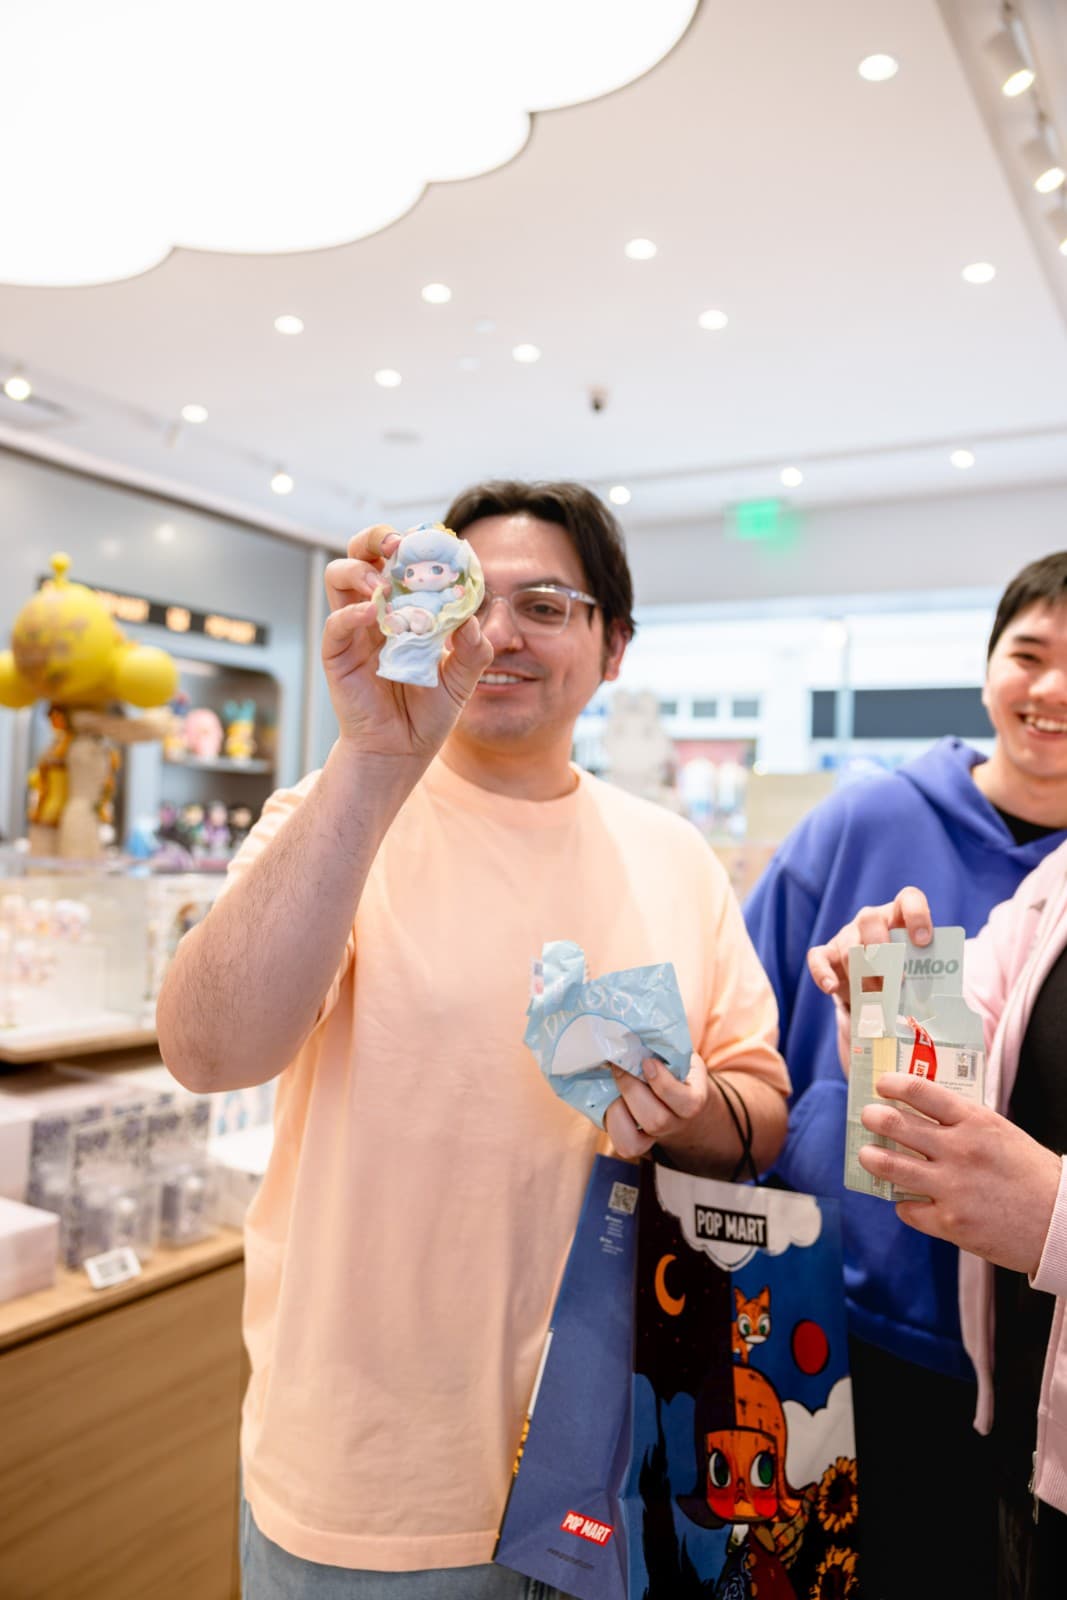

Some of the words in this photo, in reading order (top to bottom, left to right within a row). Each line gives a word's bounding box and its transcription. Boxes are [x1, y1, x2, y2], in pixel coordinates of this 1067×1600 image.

[903, 958, 959, 975] IMOO
[697, 1209, 723, 1237] POP
[725, 1213, 765, 1244] MART
[562, 1513, 585, 1531] POP
[580, 1519, 611, 1543] MART
